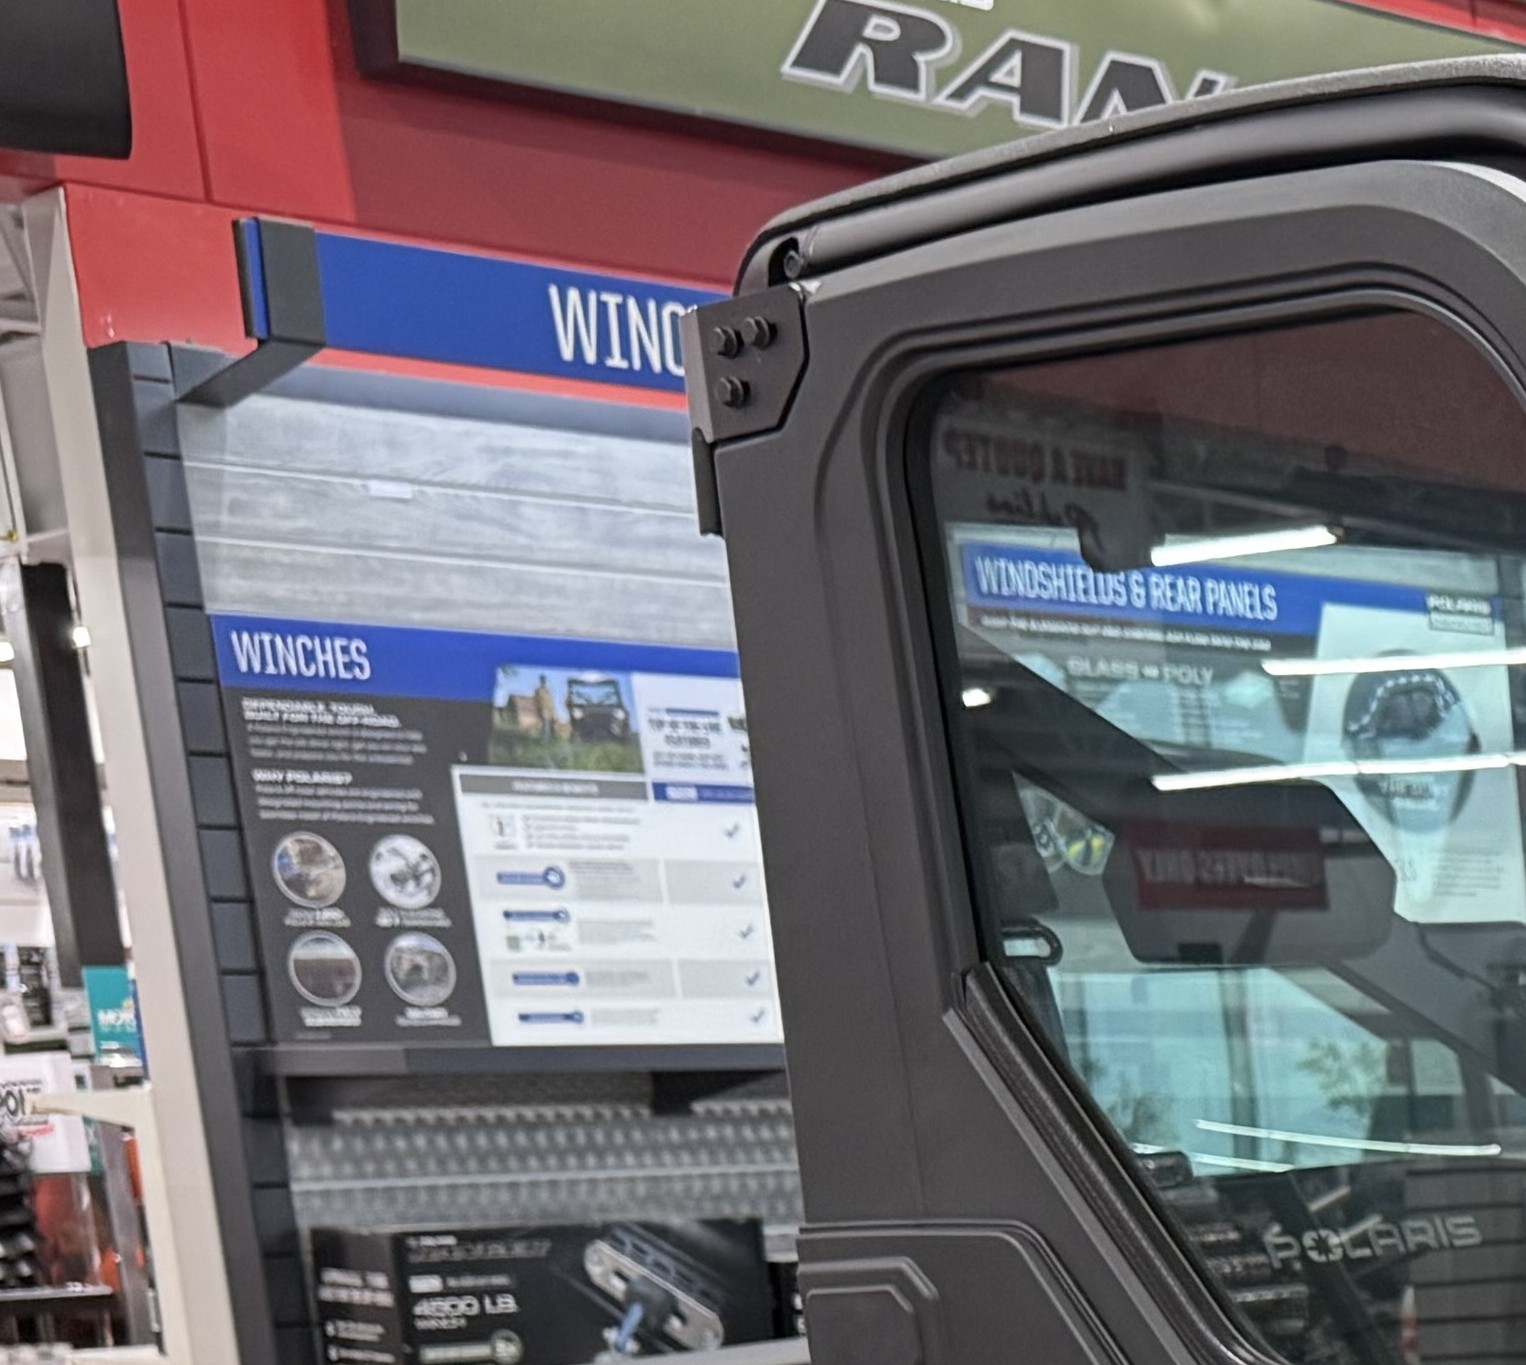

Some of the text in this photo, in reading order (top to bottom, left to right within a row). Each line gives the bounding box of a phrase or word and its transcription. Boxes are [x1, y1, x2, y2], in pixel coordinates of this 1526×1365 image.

[548, 283, 686, 378] WINC
[974, 555, 1279, 622] WINDSHIELDS & REAR PANELS
[230, 629, 372, 681] WINCHES
[1162, 662, 1214, 685] POLY
[1262, 1214, 1483, 1271] POLARIS
